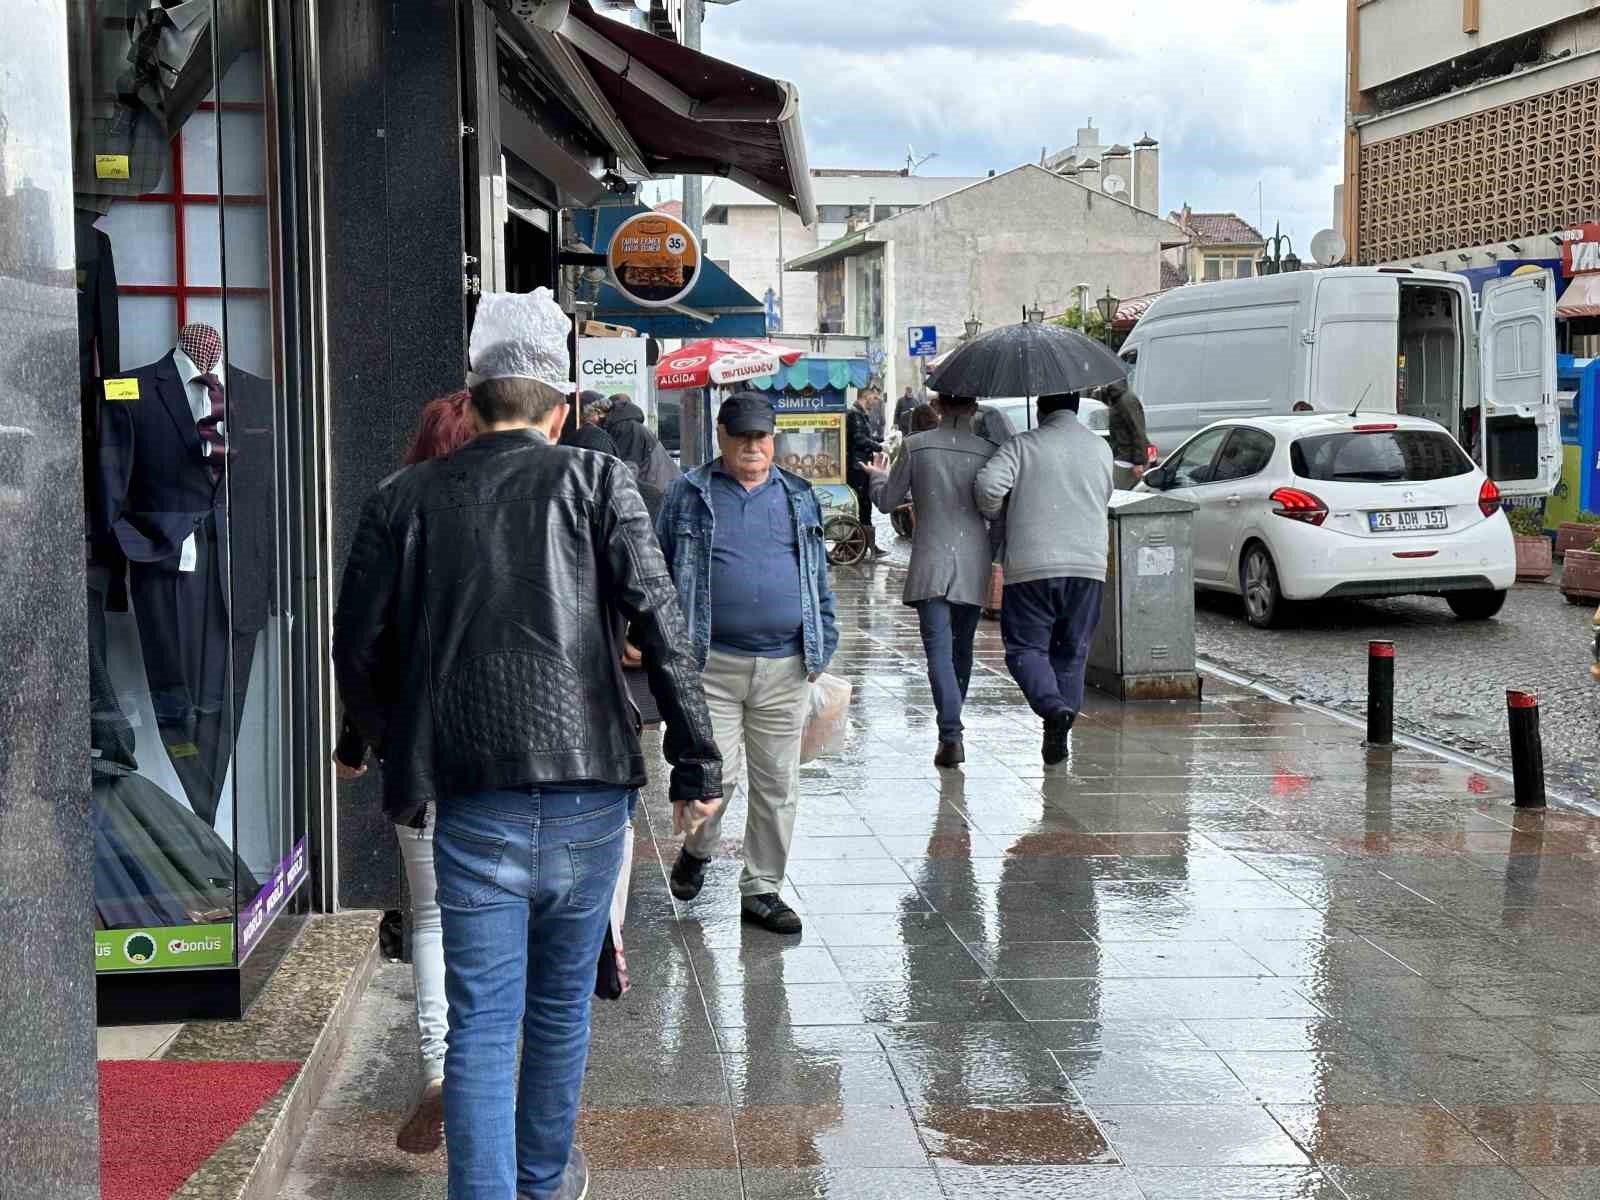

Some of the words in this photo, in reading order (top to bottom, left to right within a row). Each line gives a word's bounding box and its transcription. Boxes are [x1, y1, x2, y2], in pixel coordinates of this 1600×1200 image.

[910, 328, 923, 348] P
[1378, 513, 1392, 526] 26
[1398, 511, 1418, 525] ADH
[1425, 511, 1444, 524] 157
